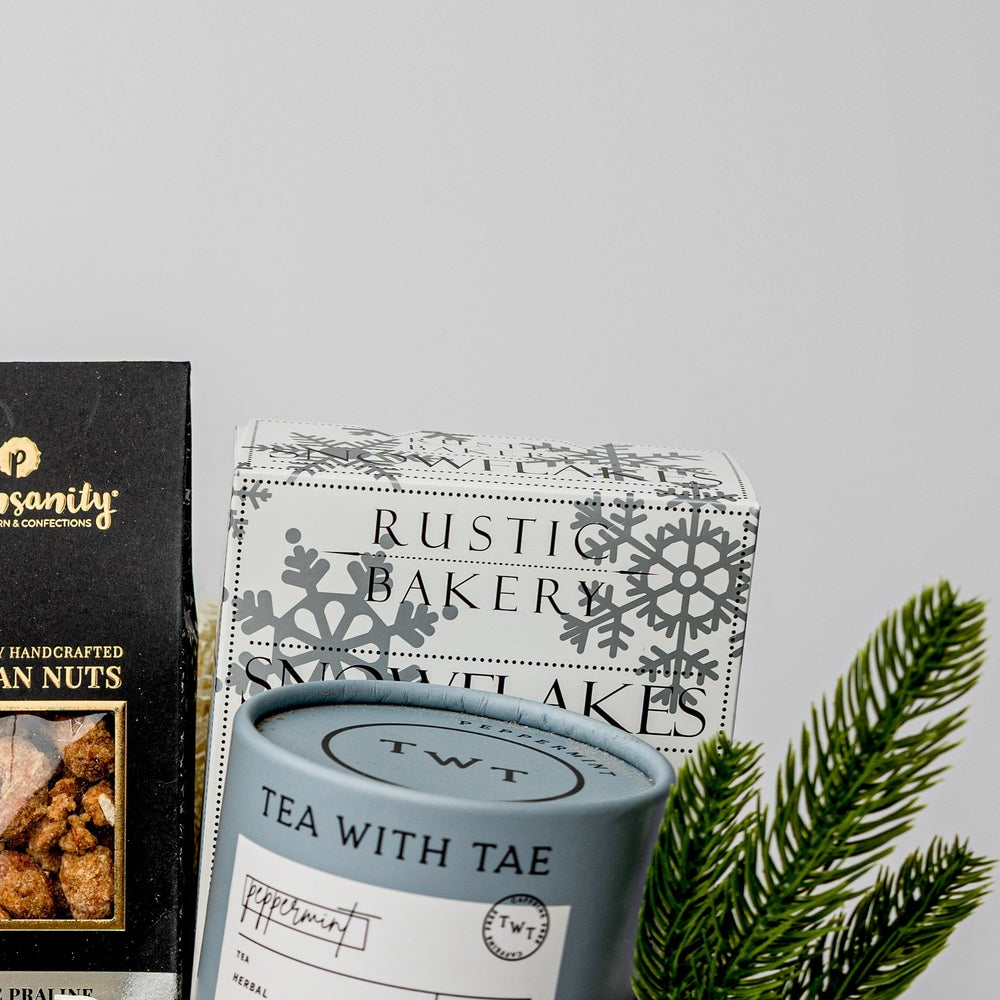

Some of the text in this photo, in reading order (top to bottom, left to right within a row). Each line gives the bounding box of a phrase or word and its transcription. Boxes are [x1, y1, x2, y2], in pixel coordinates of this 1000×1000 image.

[12, 518, 20, 528] &
[21, 518, 92, 528] CONFECTIONS
[372, 508, 610, 560] RUSTIC
[366, 566, 605, 617] BAKERY
[9, 645, 123, 660] HANDCRAFTED
[42, 665, 122, 690] NUTS
[379, 738, 528, 783] TWT
[459, 720, 617, 777] PEPPERMINT
[262, 785, 552, 876] TEA WITH TAE
[240, 879, 382, 958] peppermint
[499, 914, 537, 940] TWT
[236, 950, 250, 964] TEA
[232, 972, 268, 999] HERBAL
